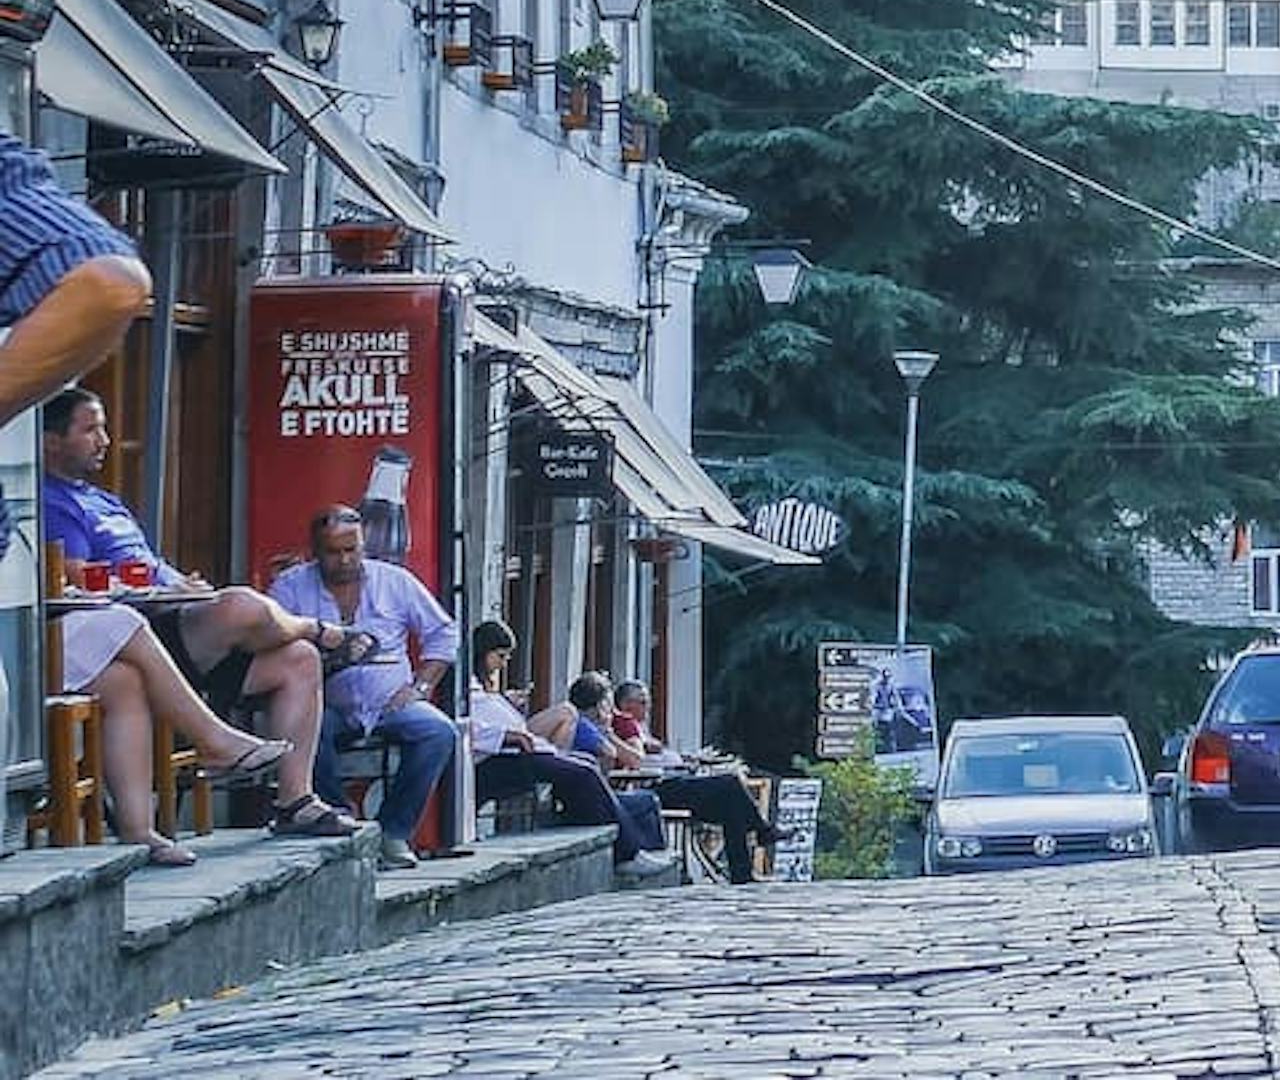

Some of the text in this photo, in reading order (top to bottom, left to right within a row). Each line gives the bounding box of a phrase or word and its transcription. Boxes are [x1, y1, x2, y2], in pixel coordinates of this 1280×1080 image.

[280, 331, 295, 352] E
[279, 373, 410, 407] AKULL
[280, 411, 299, 437] E
[753, 497, 839, 553] ANTIQUE
